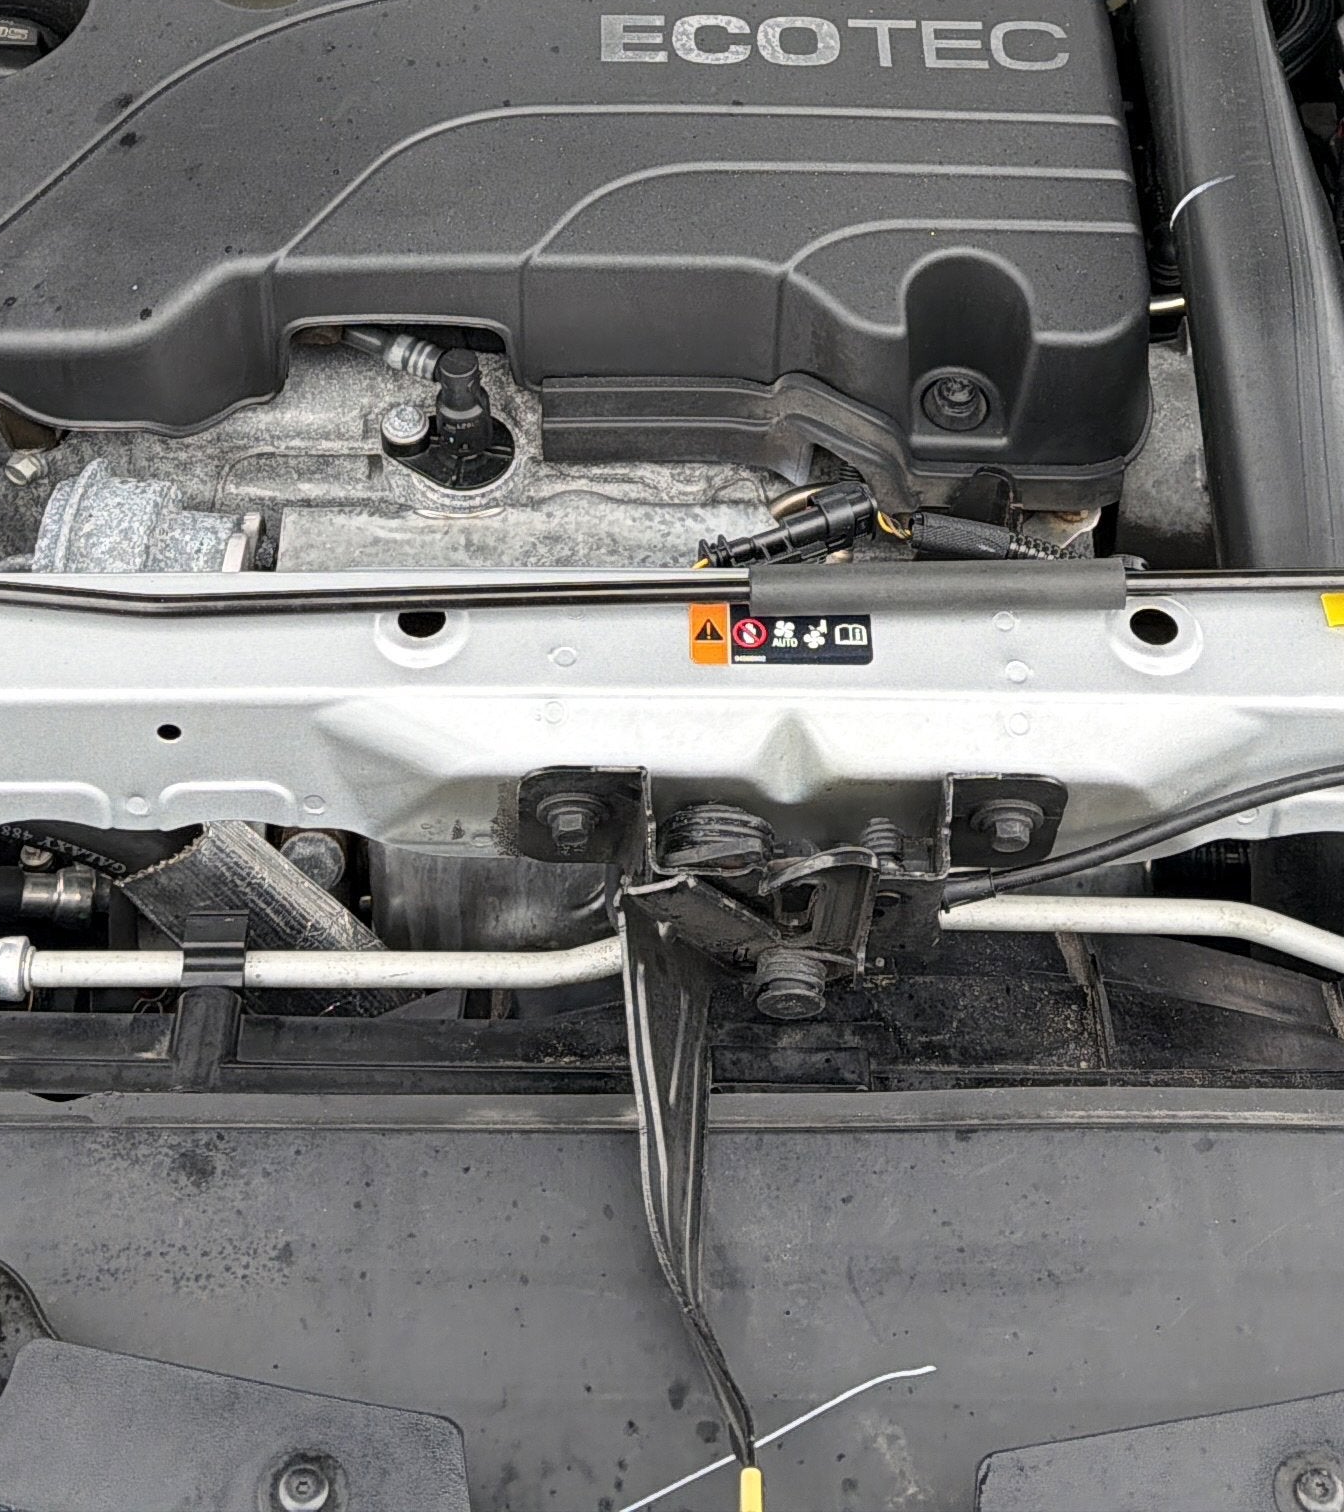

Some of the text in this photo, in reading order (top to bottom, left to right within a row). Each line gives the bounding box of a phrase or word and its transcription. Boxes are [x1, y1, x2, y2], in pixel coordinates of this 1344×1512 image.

[600, 14, 1070, 71] ECOTEC
[771, 637, 799, 648] AUTO
[36, 835, 127, 874] GALAXY
